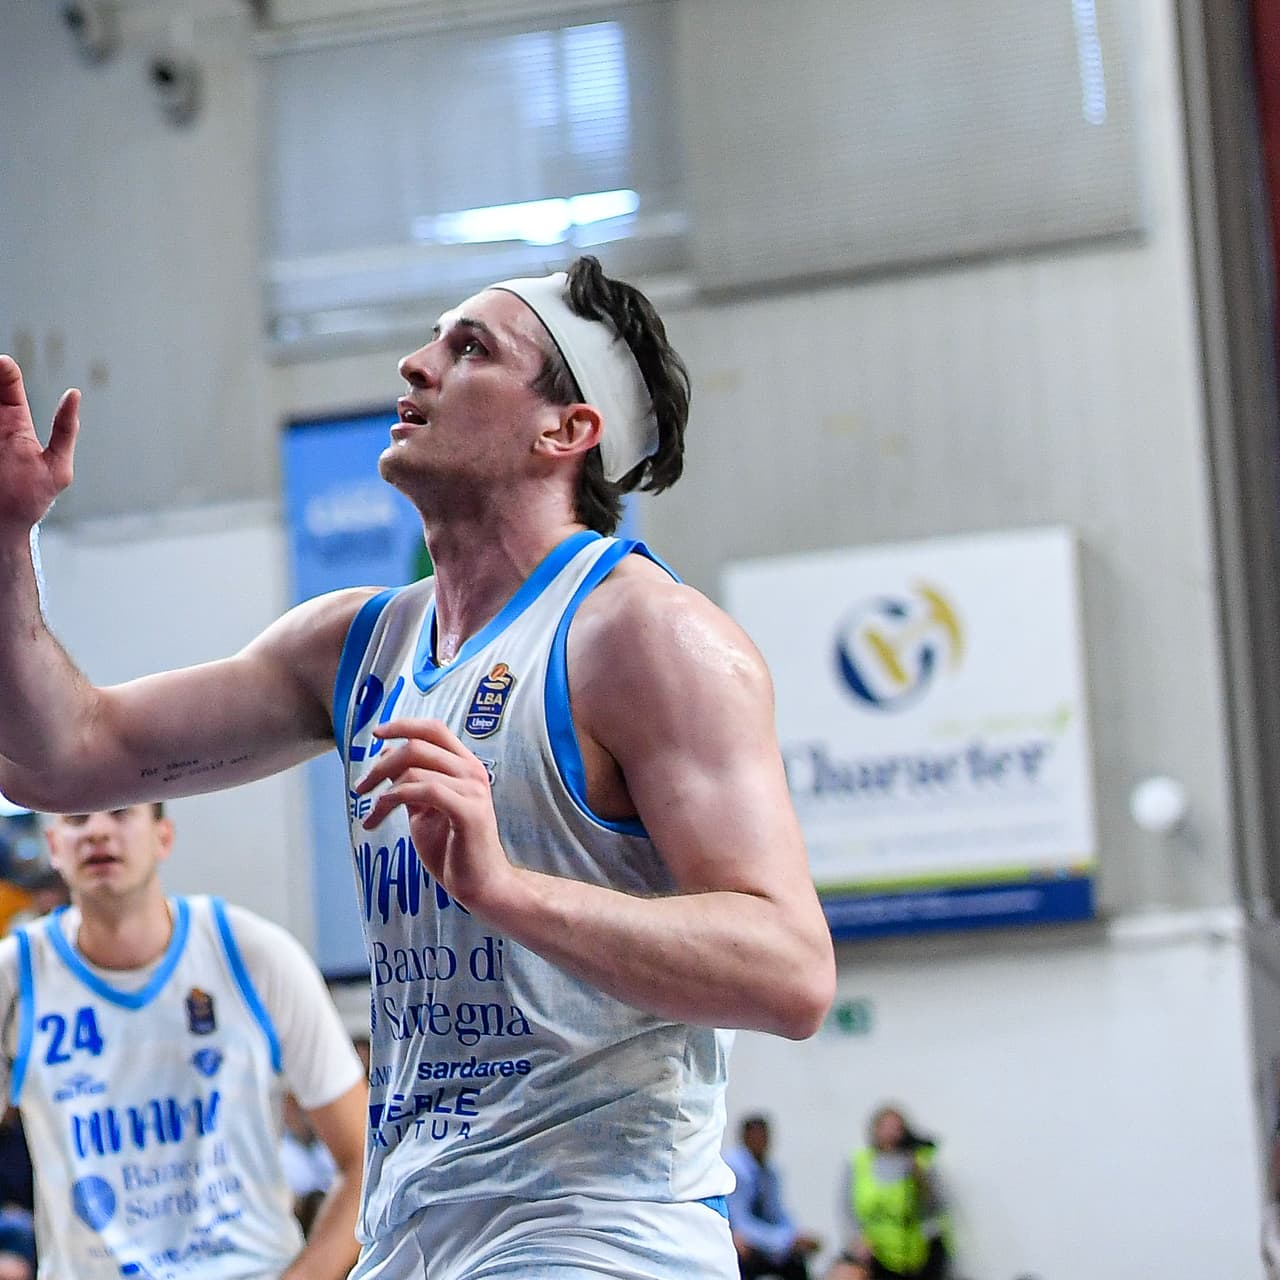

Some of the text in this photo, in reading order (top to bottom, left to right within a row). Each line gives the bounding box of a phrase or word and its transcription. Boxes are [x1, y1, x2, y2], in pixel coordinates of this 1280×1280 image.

[476, 692, 503, 705] LBA
[469, 936, 505, 982] di
[39, 1006, 104, 1065] 24
[418, 1056, 532, 1081] sardares
